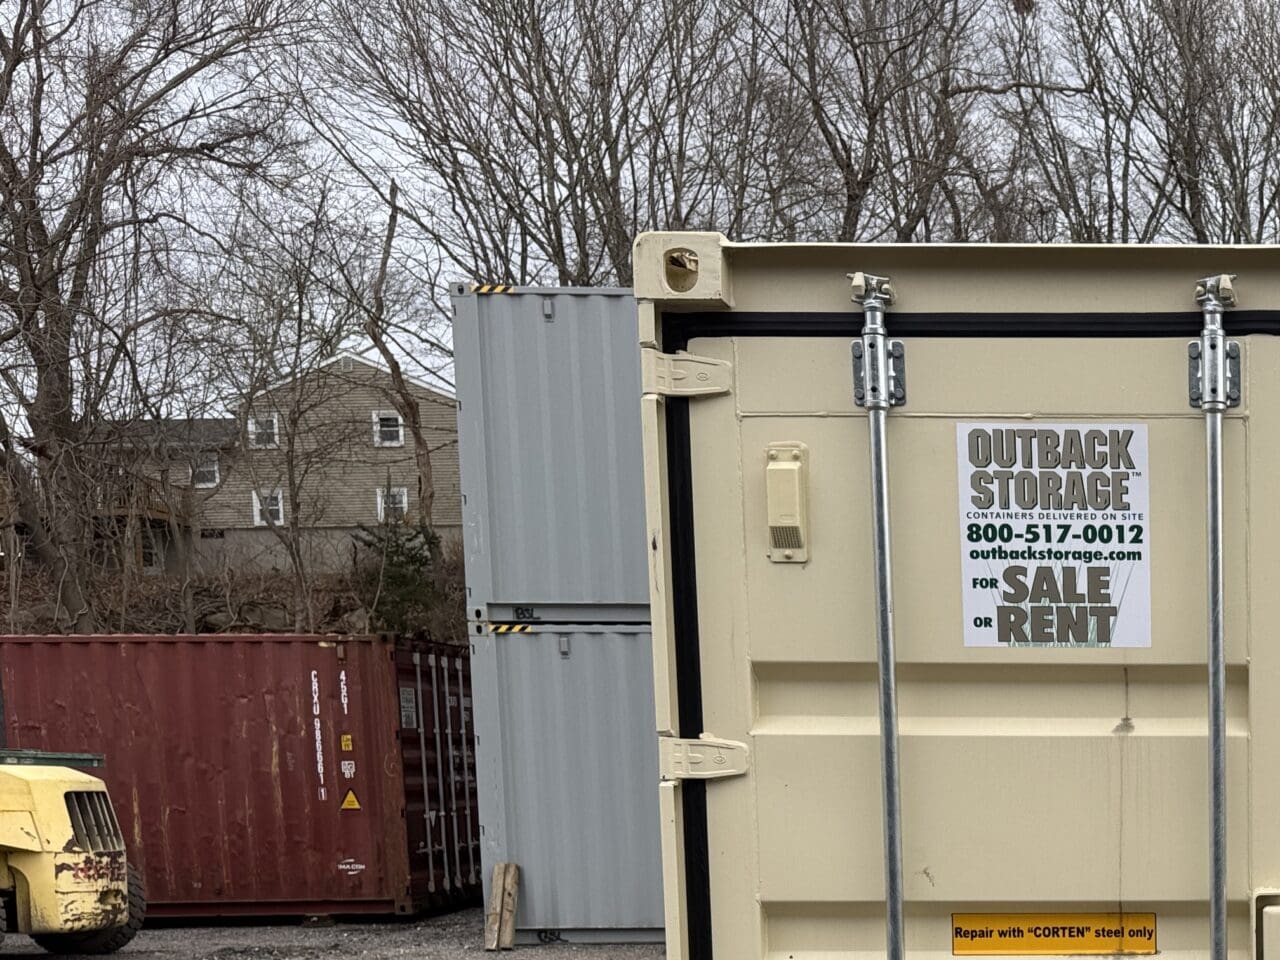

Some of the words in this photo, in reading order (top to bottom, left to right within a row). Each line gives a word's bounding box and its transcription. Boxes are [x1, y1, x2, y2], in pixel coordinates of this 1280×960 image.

[968, 428, 1136, 470] OUTBACK
[970, 470, 1130, 511] STORAGE
[966, 512, 1034, 520] CONTAINERS
[1038, 512, 1097, 520] DELIVERED
[1102, 512, 1117, 520] ON
[1122, 513, 1144, 521] SITE
[966, 524, 1144, 544] 800-517-0012
[970, 546, 1142, 563] outbackstorage.com
[972, 578, 998, 589] FOR
[1002, 566, 1112, 604] SALE
[974, 617, 992, 628] OR
[997, 606, 1118, 643] RENT
[954, 927, 993, 941] Repair
[998, 927, 1024, 938] with
[1095, 927, 1124, 938] steel
[1128, 927, 1154, 940] only
